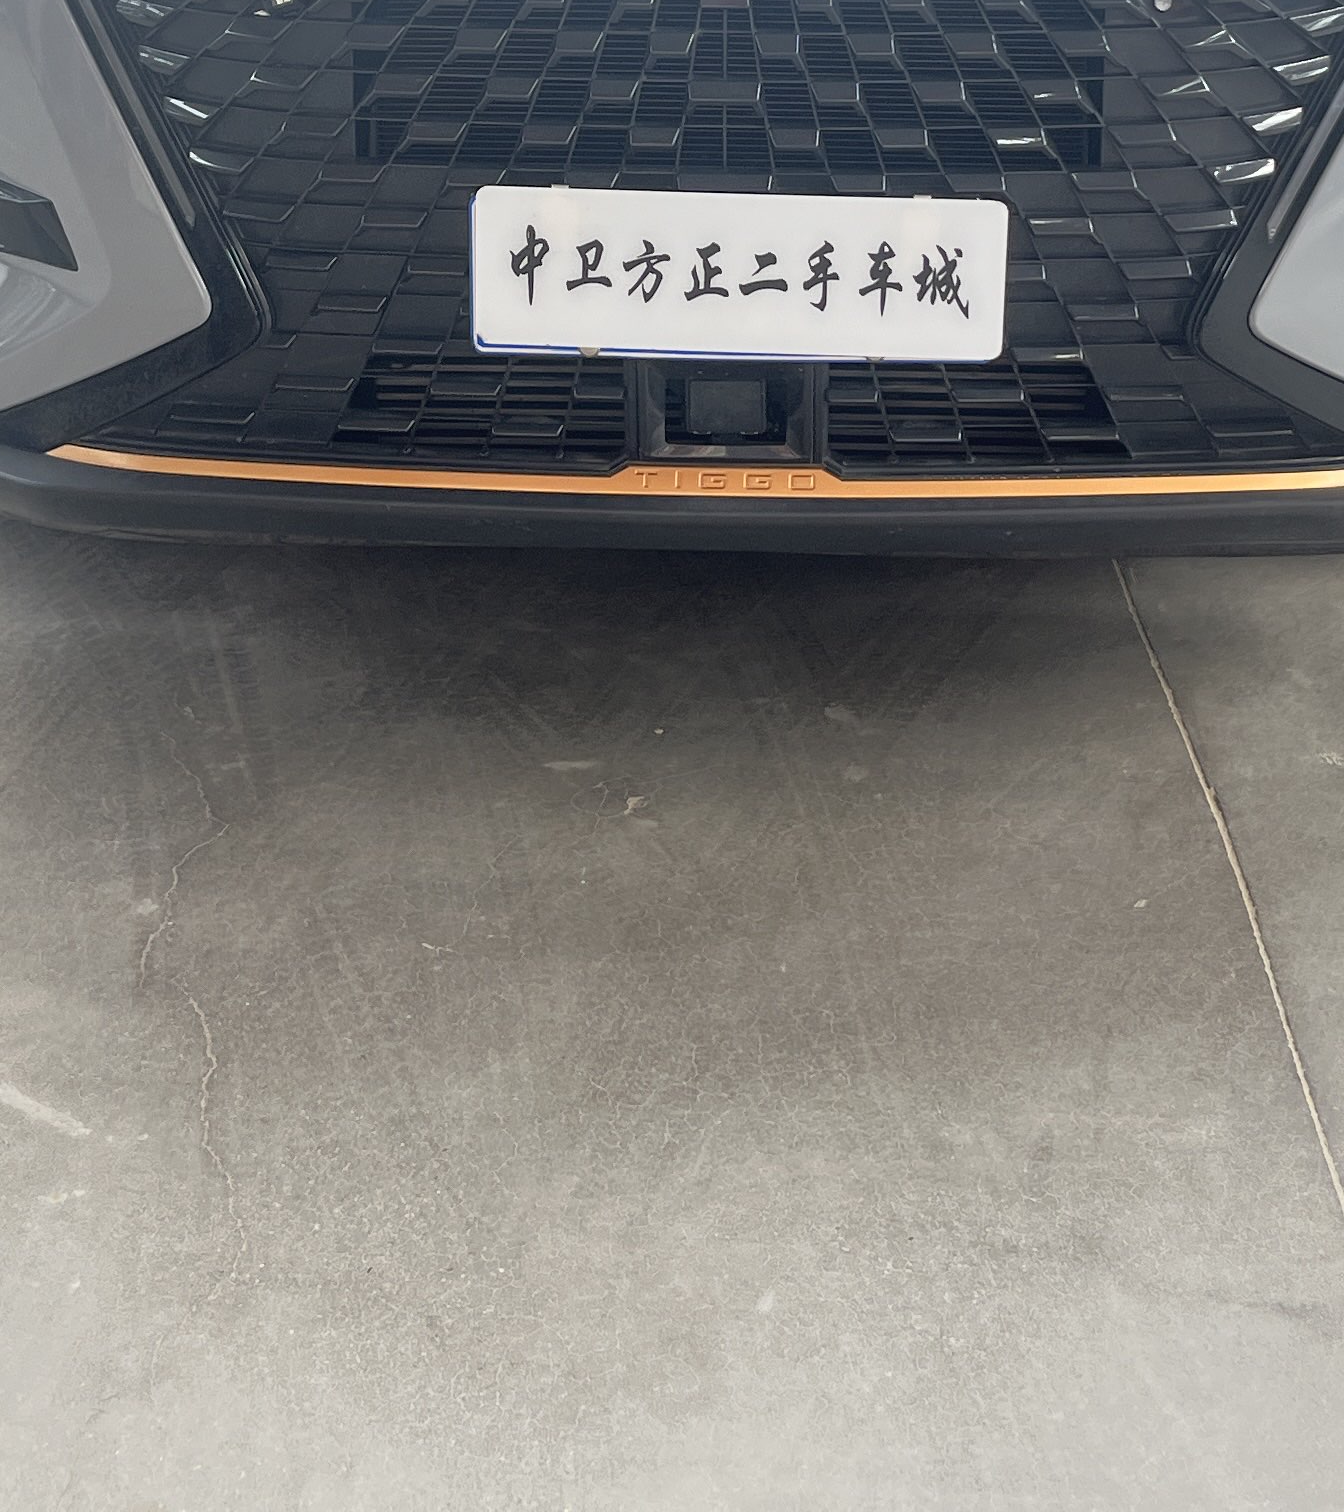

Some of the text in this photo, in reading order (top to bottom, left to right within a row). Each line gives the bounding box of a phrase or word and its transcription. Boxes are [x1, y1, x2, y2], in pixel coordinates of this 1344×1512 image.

[509, 224, 969, 319] 中卫方正二手车城
[634, 469, 816, 490] TIGGO
